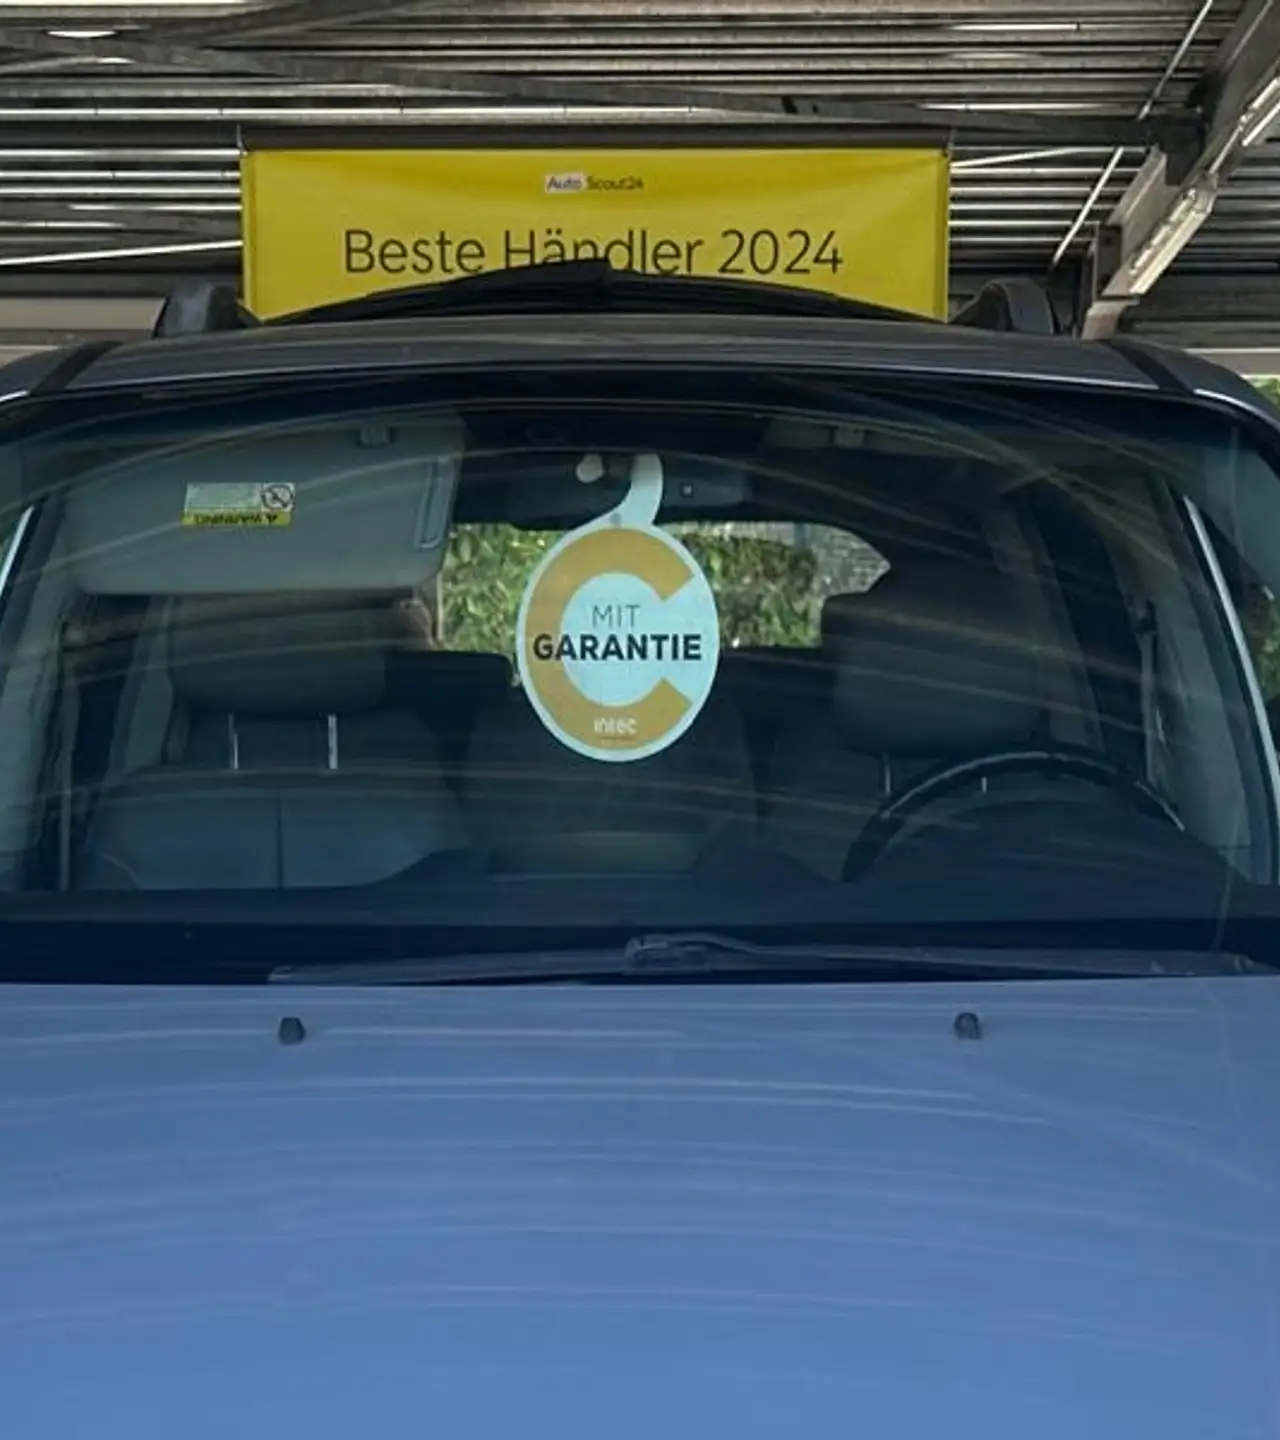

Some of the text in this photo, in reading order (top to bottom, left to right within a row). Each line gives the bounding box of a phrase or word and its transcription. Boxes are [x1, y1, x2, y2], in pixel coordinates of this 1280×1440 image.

[344, 228, 844, 275] Beste Händler 2024
[591, 604, 641, 628] MIT
[532, 633, 703, 661] GARANTIE
